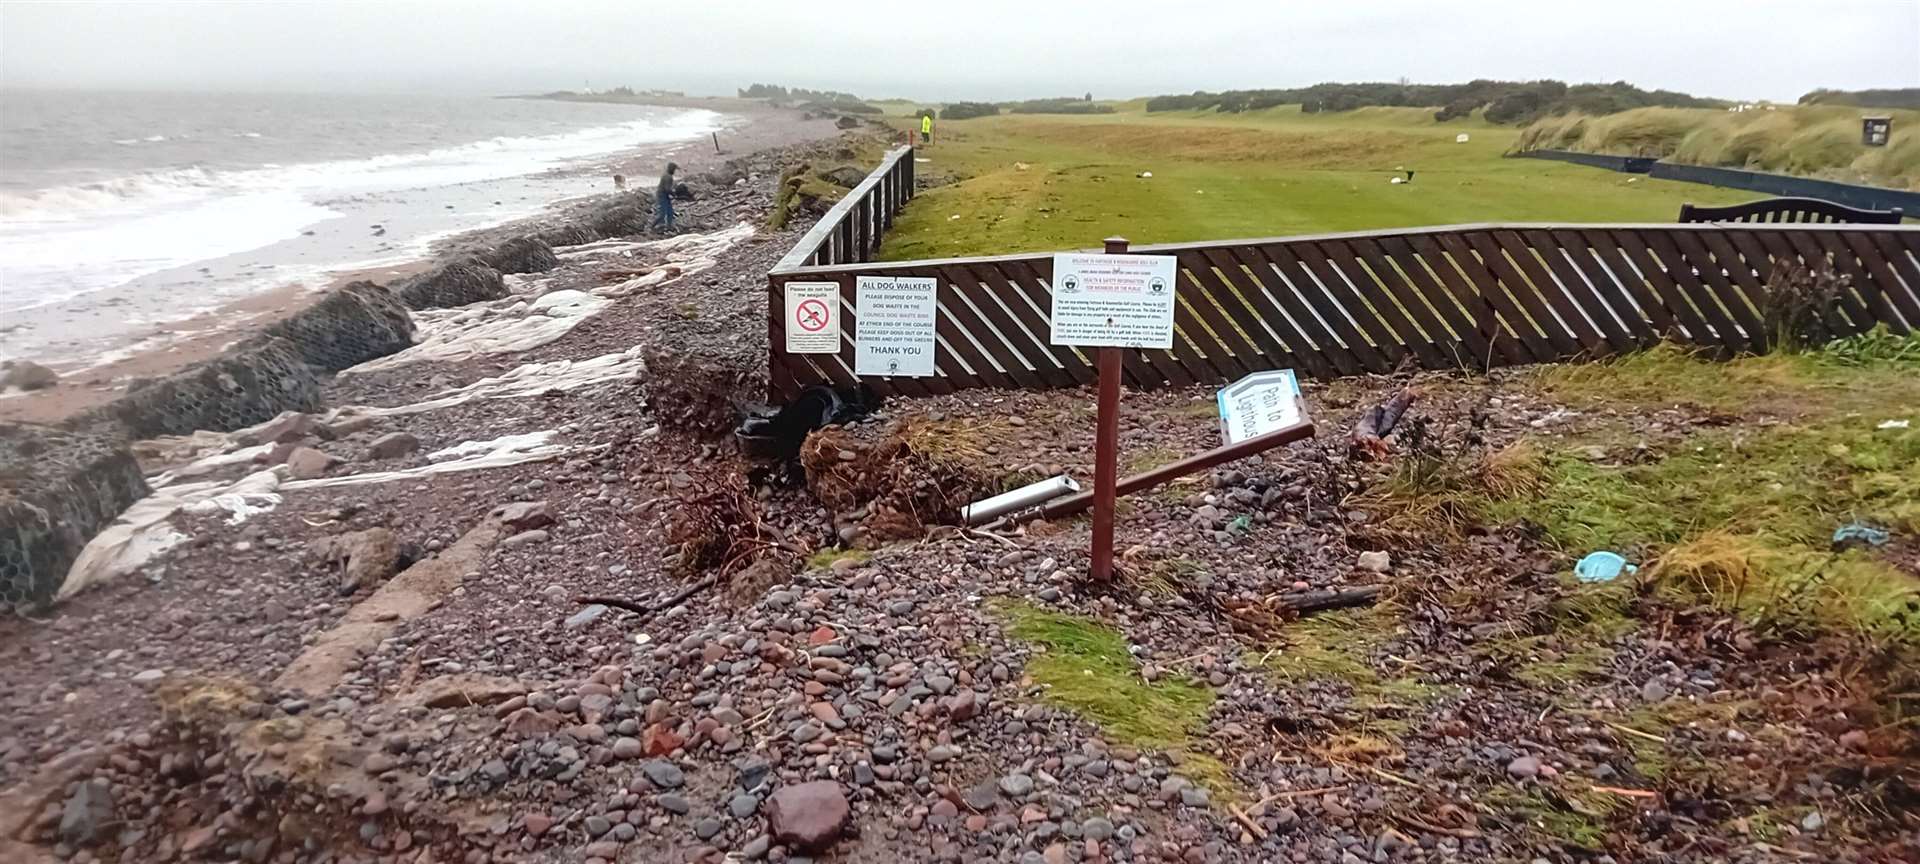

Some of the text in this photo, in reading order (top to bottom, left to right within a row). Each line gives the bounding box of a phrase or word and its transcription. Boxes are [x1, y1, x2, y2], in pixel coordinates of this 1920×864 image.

[1236, 394, 1258, 438] Lighthous
[1262, 386, 1284, 422] Path to
